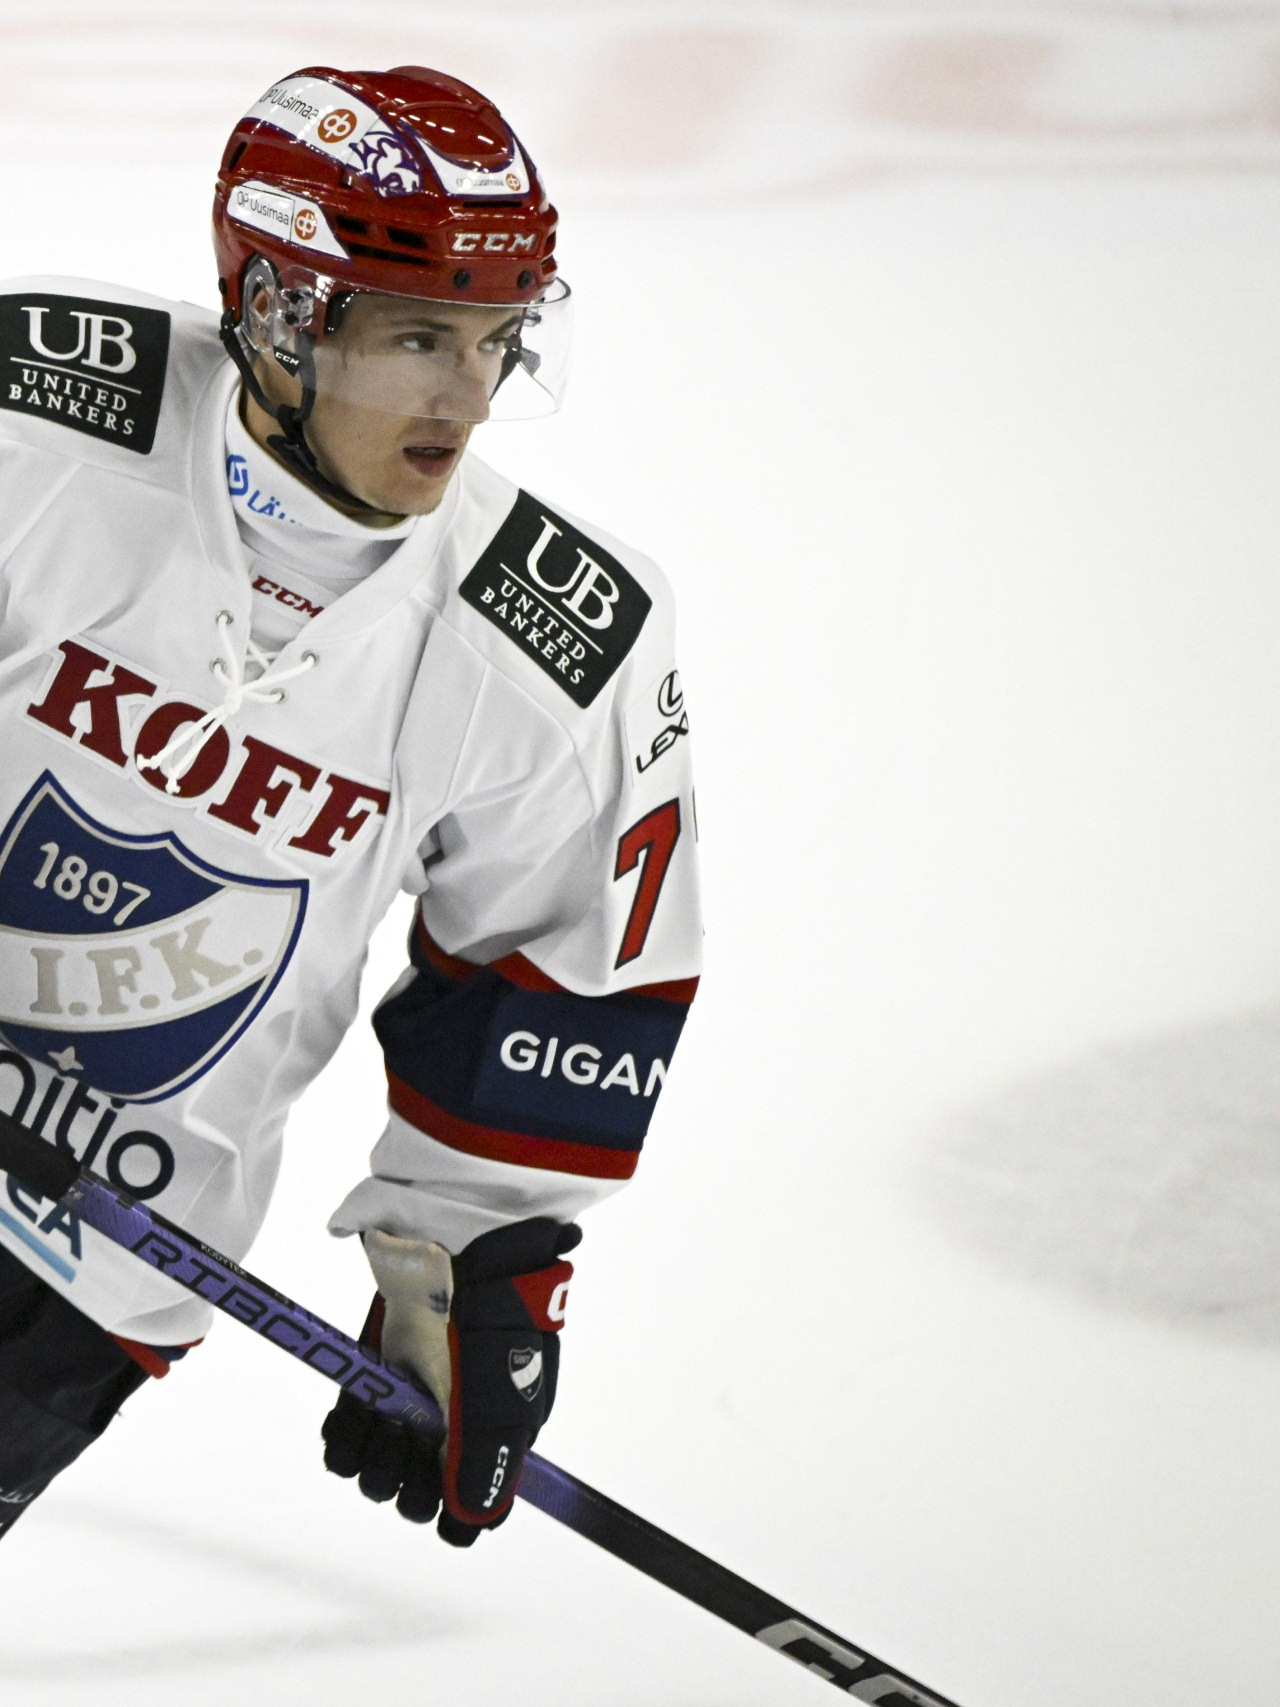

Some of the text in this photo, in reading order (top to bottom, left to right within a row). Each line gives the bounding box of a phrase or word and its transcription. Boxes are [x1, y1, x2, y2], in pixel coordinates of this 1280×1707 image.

[250, 197, 290, 226] Uusimaa
[451, 232, 538, 253] CCM
[21, 306, 138, 375] UB
[274, 351, 300, 366] CCM
[8, 383, 136, 436] BANKERS
[22, 368, 128, 412] UNITED
[251, 575, 325, 619] CCM
[526, 515, 621, 630] UB
[480, 586, 585, 685] BANKERS
[500, 579, 587, 661] UNITED
[26, 639, 391, 858] KOFF
[33, 841, 151, 926] 1897
[613, 796, 682, 972] 7
